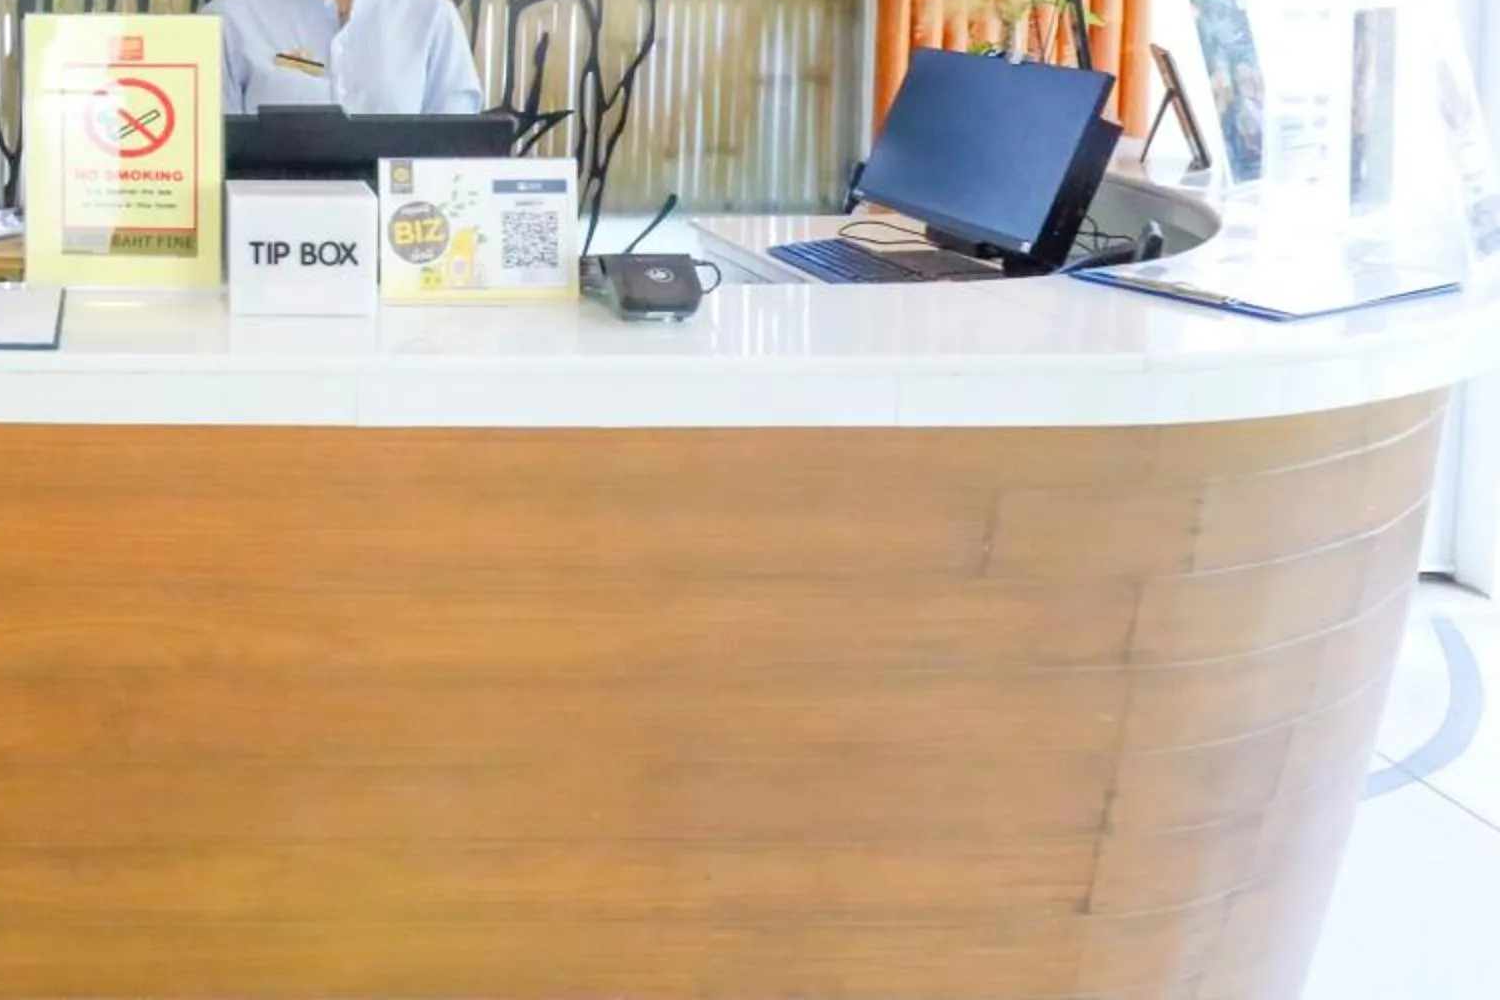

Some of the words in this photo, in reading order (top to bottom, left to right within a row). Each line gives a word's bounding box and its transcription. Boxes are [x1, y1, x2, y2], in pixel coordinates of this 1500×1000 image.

[75, 169, 99, 181] NO
[105, 170, 184, 182] SMOKING
[157, 234, 196, 249] FINE
[394, 219, 444, 244] BIZ
[249, 241, 290, 265] TIP
[300, 241, 359, 267] BOX
